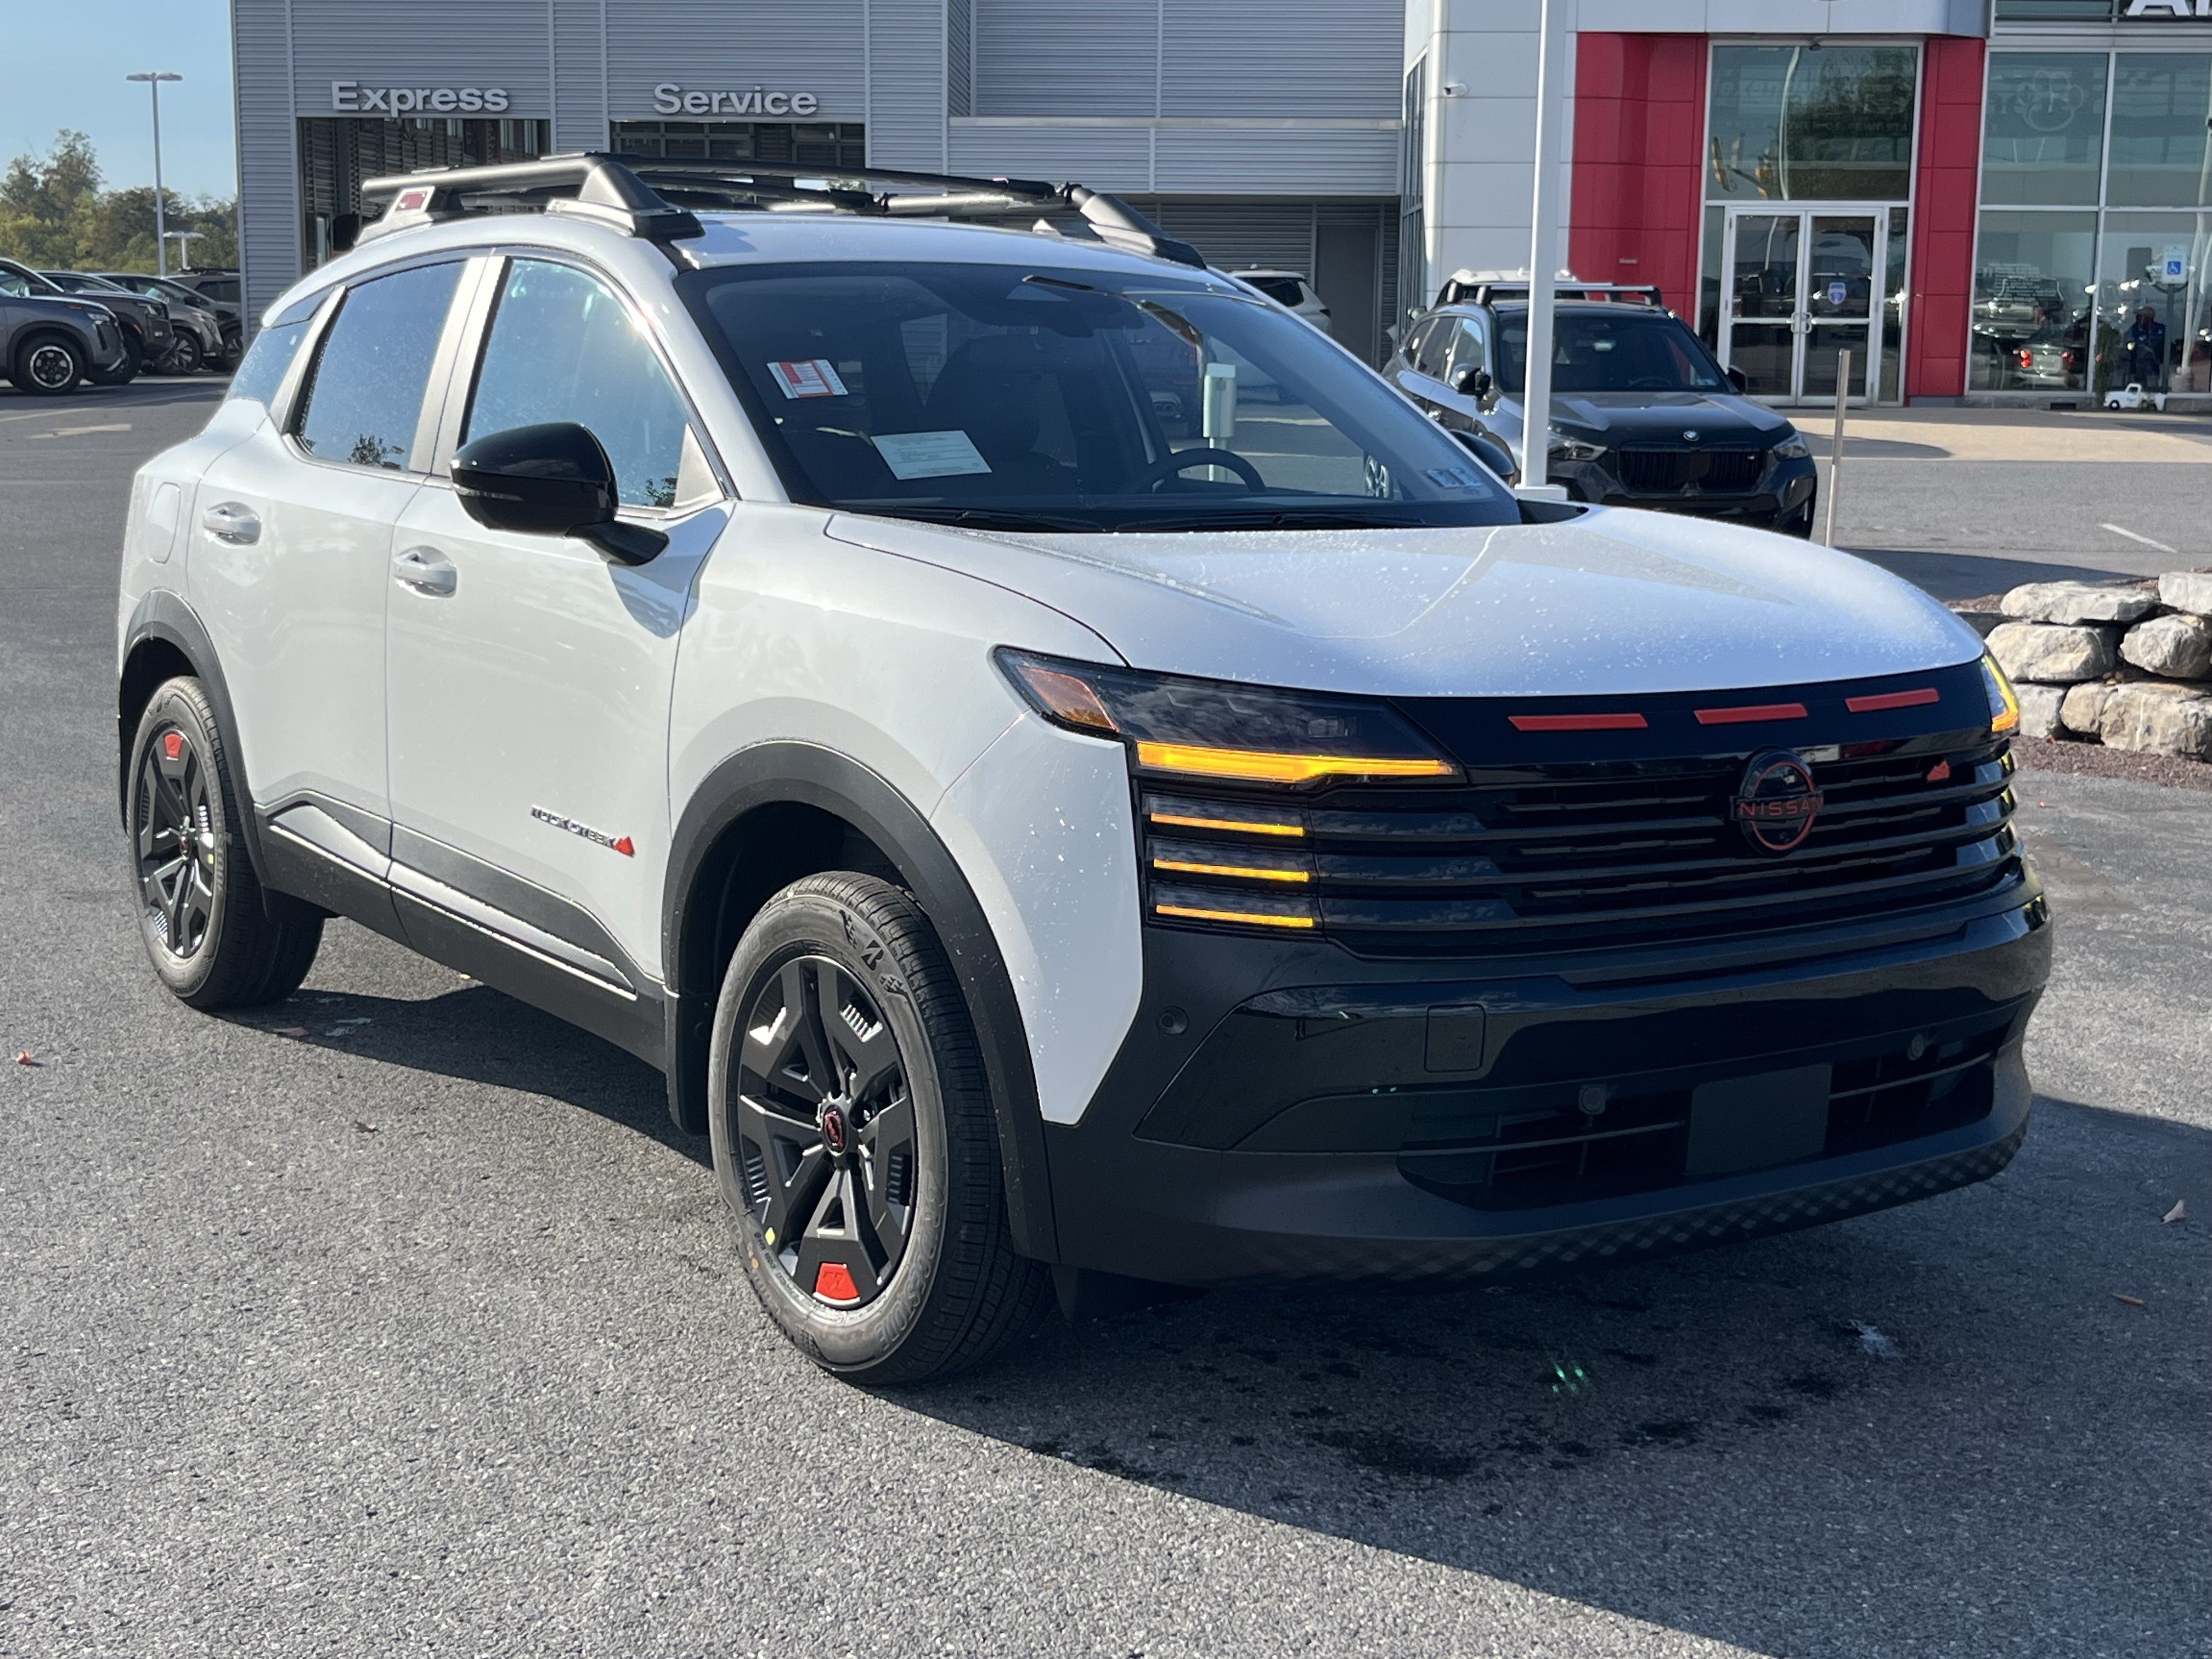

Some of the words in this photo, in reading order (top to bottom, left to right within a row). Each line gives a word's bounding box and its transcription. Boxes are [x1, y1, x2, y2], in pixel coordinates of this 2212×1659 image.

[332, 81, 509, 117] Express
[653, 83, 817, 115] Service
[1738, 795, 1824, 816] NISSAN
